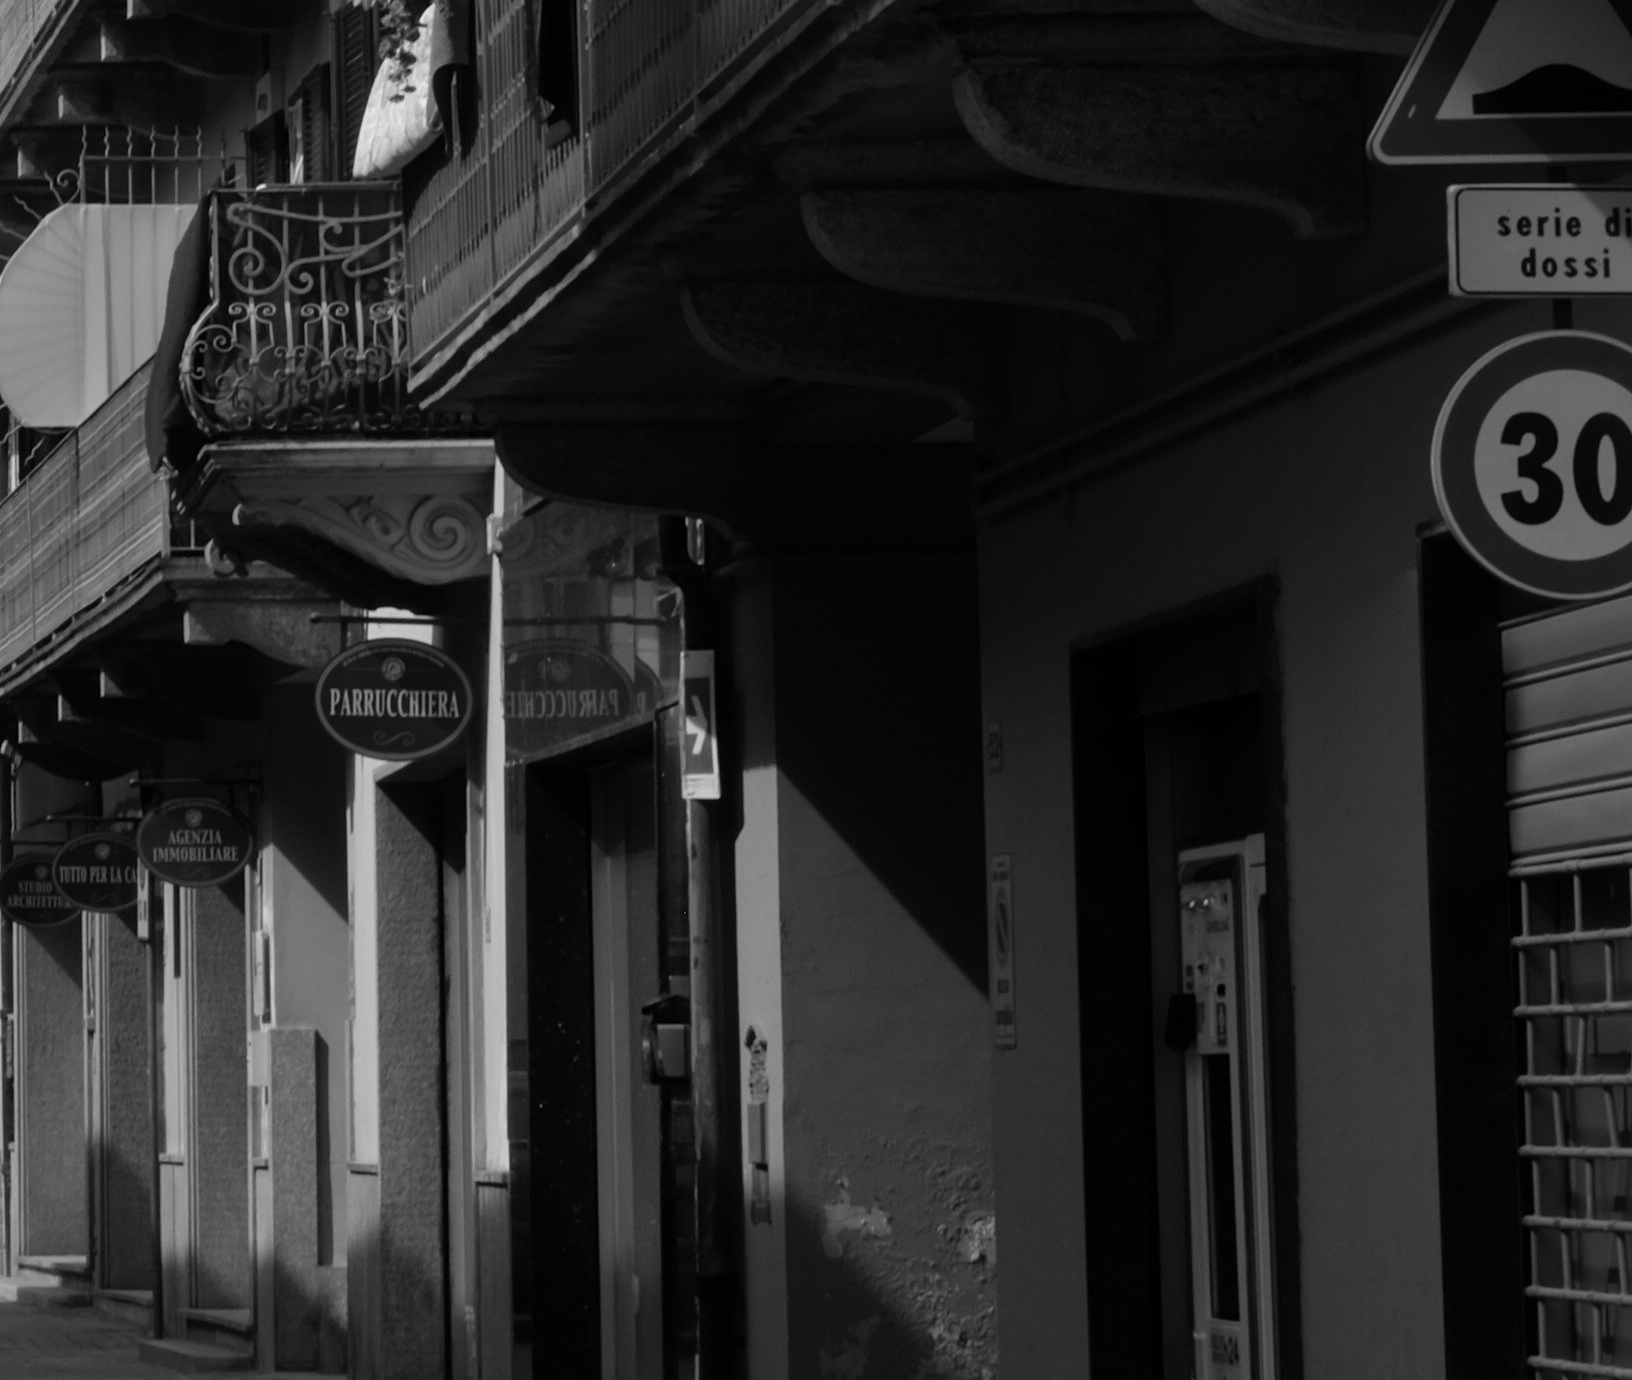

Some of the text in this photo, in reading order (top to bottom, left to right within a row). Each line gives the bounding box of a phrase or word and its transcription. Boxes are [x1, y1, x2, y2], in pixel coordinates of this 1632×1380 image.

[1497, 207, 1632, 237] serie di
[1521, 247, 1611, 278] dossi
[1500, 411, 1632, 526] 30
[329, 687, 460, 719] PARRUCCHIERA
[168, 829, 222, 844] AGENZIA
[152, 846, 239, 863] IMMOBILIARE
[59, 866, 88, 884] TUTTO
[89, 866, 108, 884] PER
[110, 867, 123, 884] LA
[14, 880, 53, 895] STUDIO
